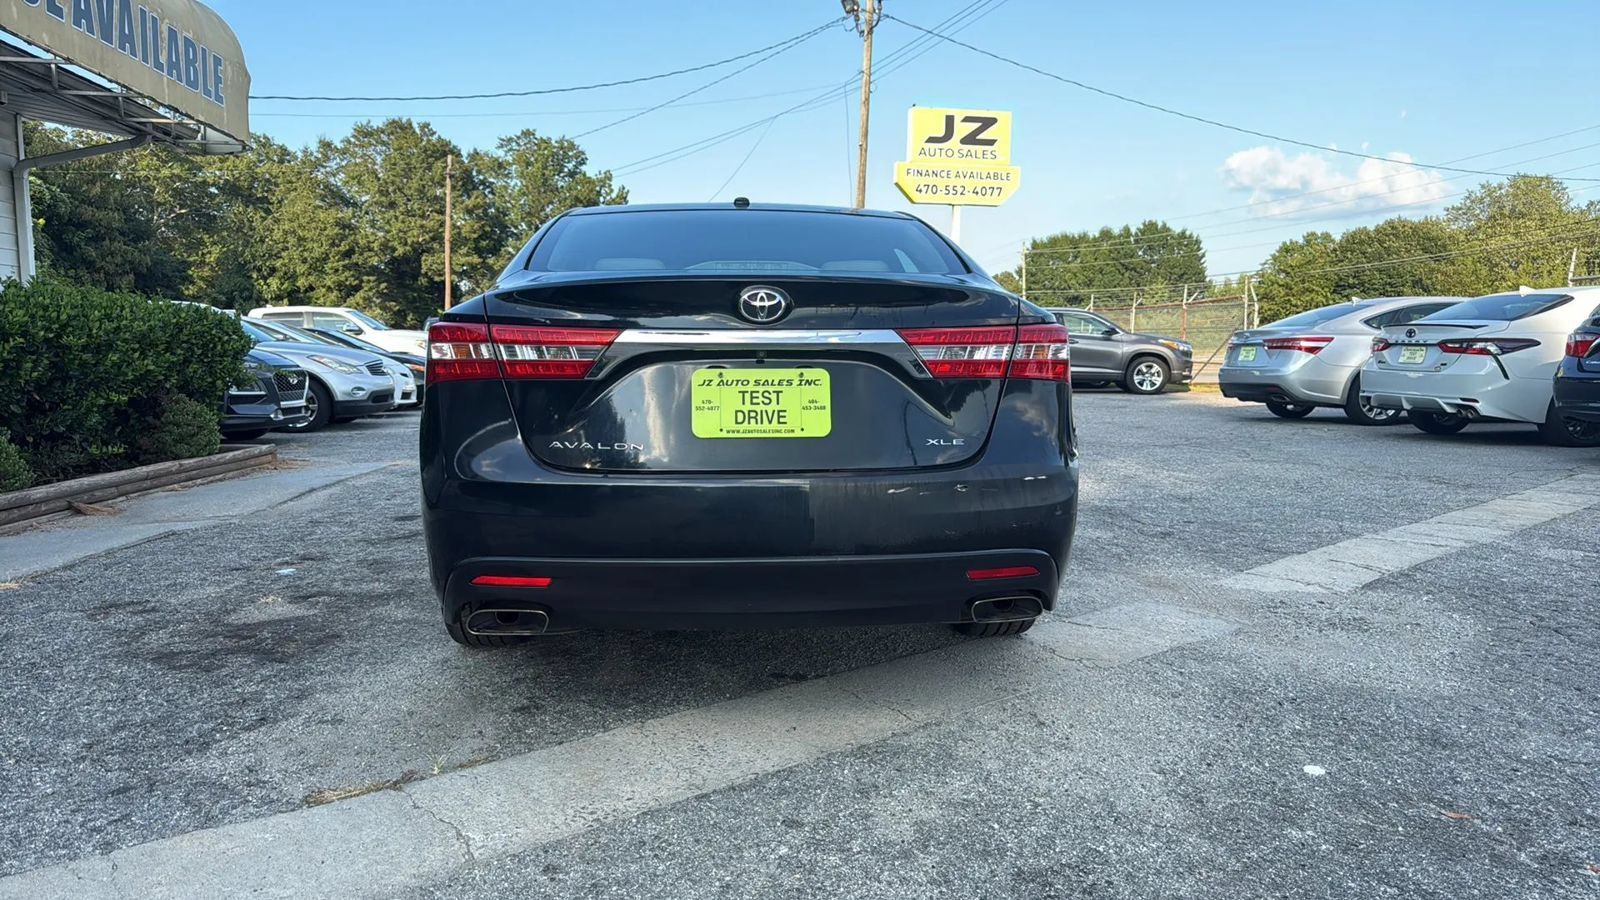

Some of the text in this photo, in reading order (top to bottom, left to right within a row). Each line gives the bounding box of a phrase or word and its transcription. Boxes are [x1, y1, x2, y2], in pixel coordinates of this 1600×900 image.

[924, 114, 998, 146] JZ
[918, 147, 997, 160] AUTO SALES
[906, 168, 1011, 181] FINANCE AVAILABLE
[915, 184, 1002, 197] 470-552-4077
[697, 379, 822, 387] JZ AUTO SALES INC.
[738, 390, 783, 406] TEST
[734, 409, 788, 425] DRIVE
[549, 441, 644, 450] AVALON
[925, 438, 965, 446] XLE
